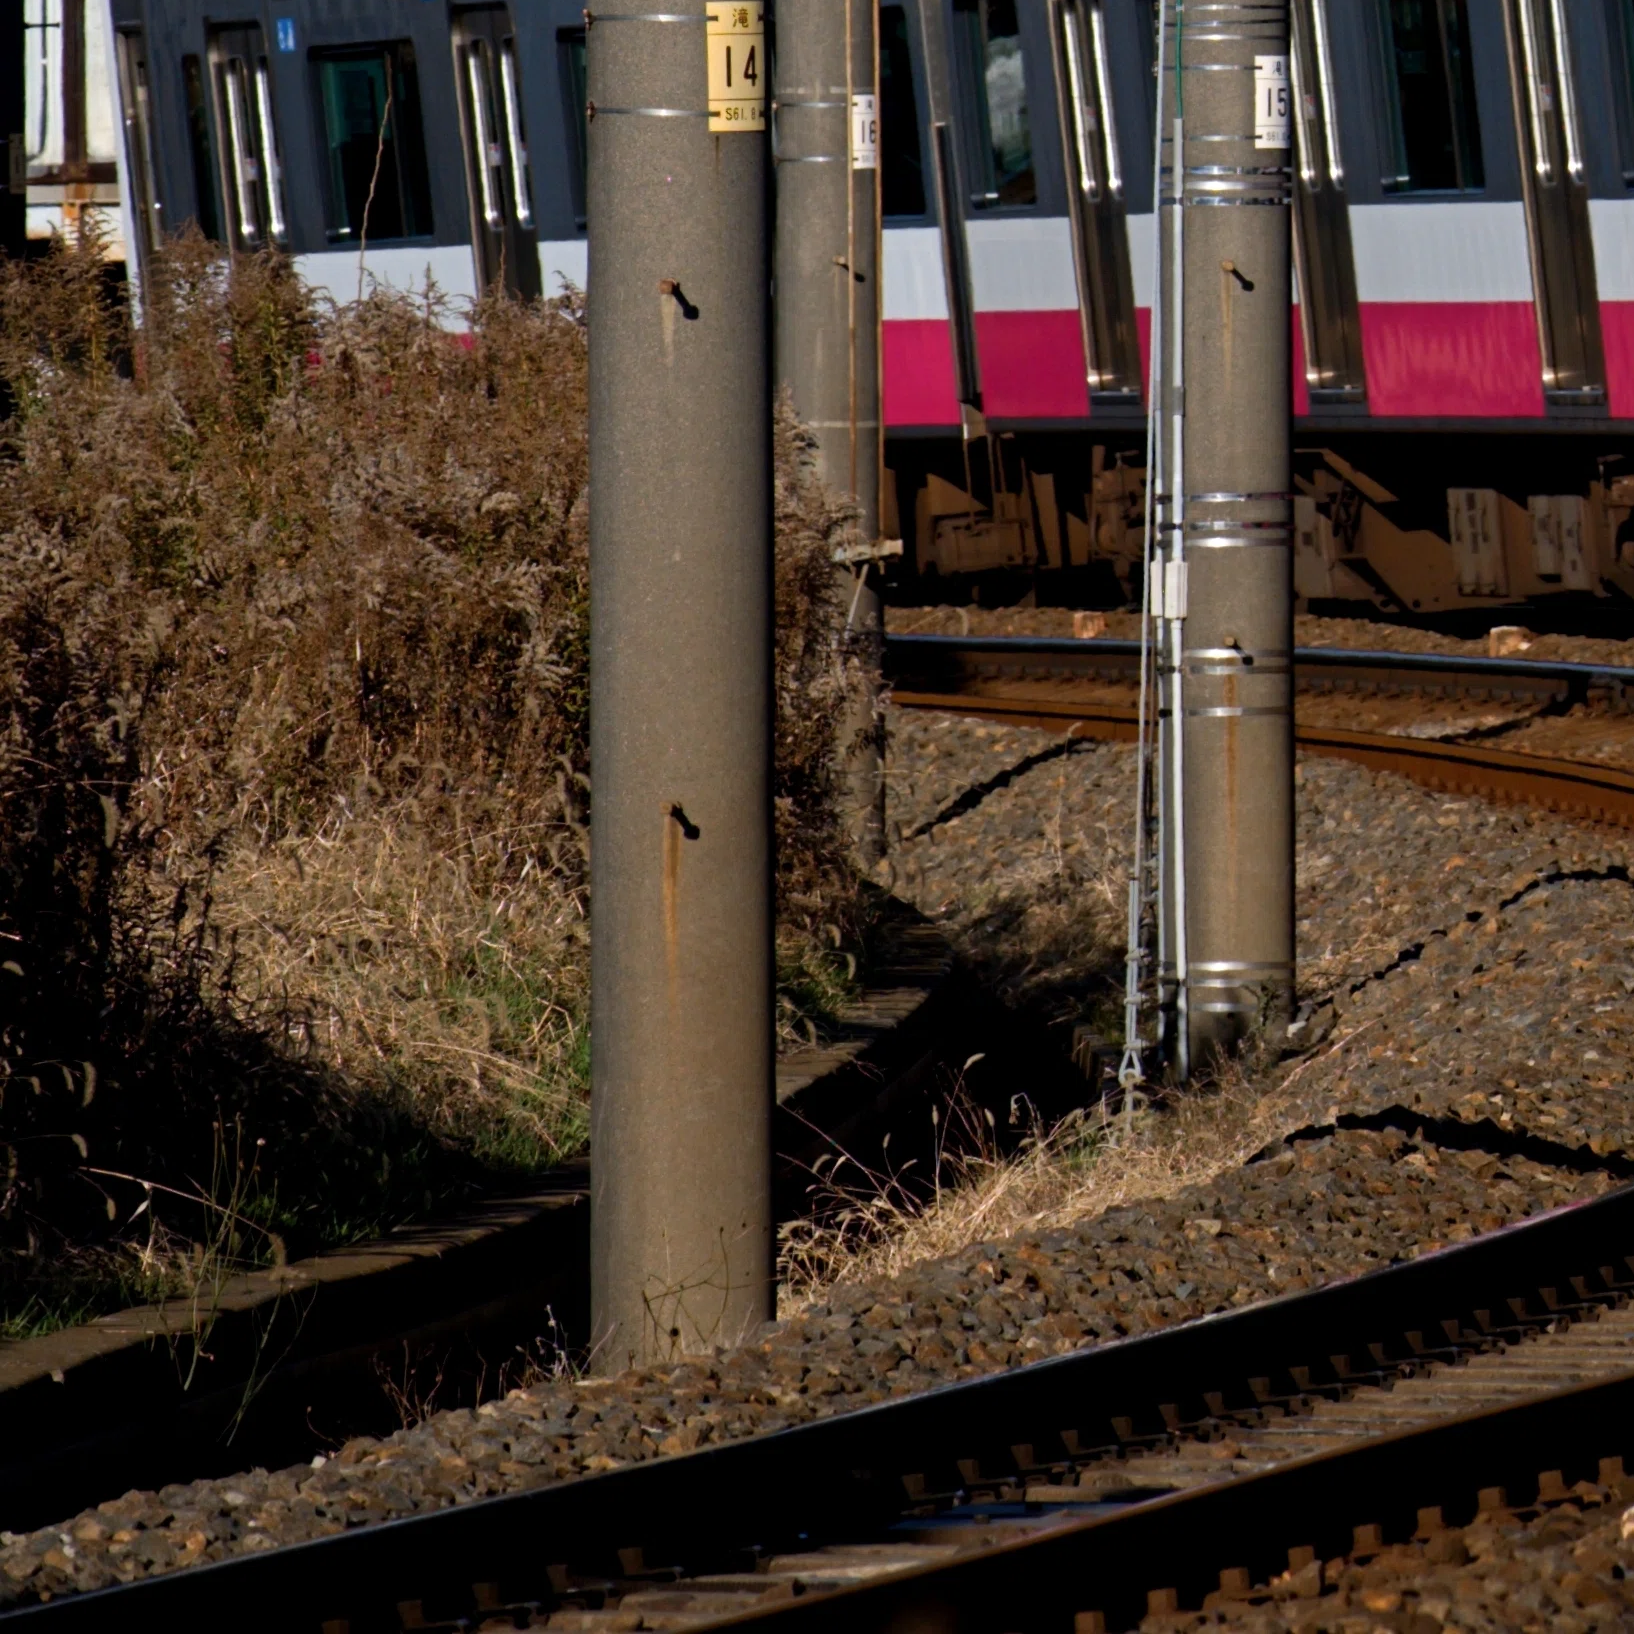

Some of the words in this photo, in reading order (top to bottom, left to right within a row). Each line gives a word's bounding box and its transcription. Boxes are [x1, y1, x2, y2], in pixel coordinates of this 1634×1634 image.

[732, 7, 749, 28] 滝
[725, 45, 758, 87] 14
[1267, 87, 1287, 118] 15
[861, 119, 876, 144] 16
